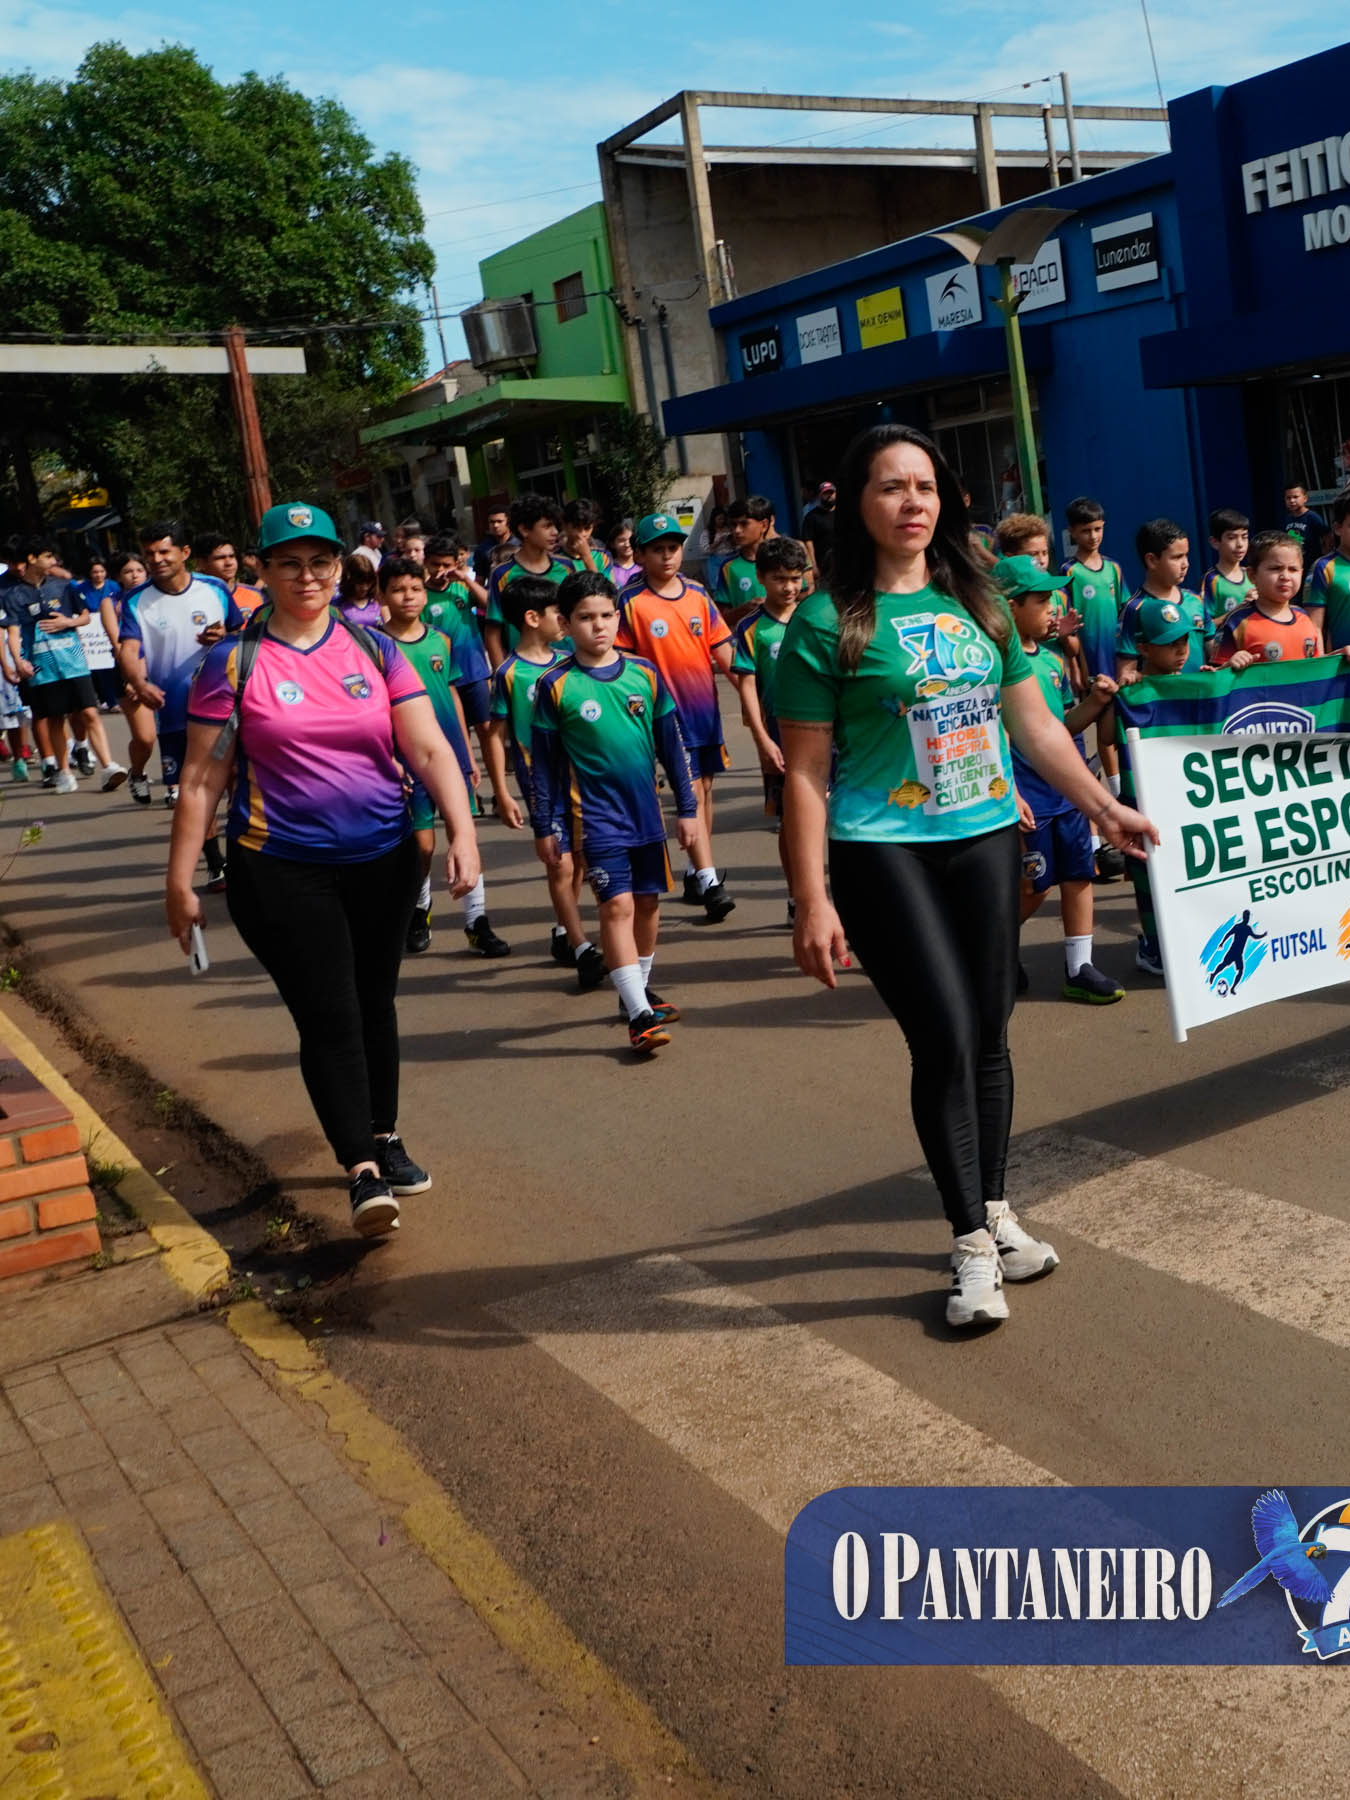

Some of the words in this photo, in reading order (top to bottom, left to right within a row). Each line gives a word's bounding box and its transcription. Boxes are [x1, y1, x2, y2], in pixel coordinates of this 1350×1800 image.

[1096, 238, 1150, 269] Lunender
[1020, 262, 1058, 292] PACO
[937, 308, 974, 329] MARESIA
[742, 339, 777, 370] LUPO
[912, 698, 978, 721] NATUREZA
[928, 753, 945, 765] QUE
[933, 753, 982, 777] FUTURO
[960, 763, 997, 783] GENTE
[1181, 815, 1246, 880] DE
[1270, 928, 1327, 962] FUTSAL
